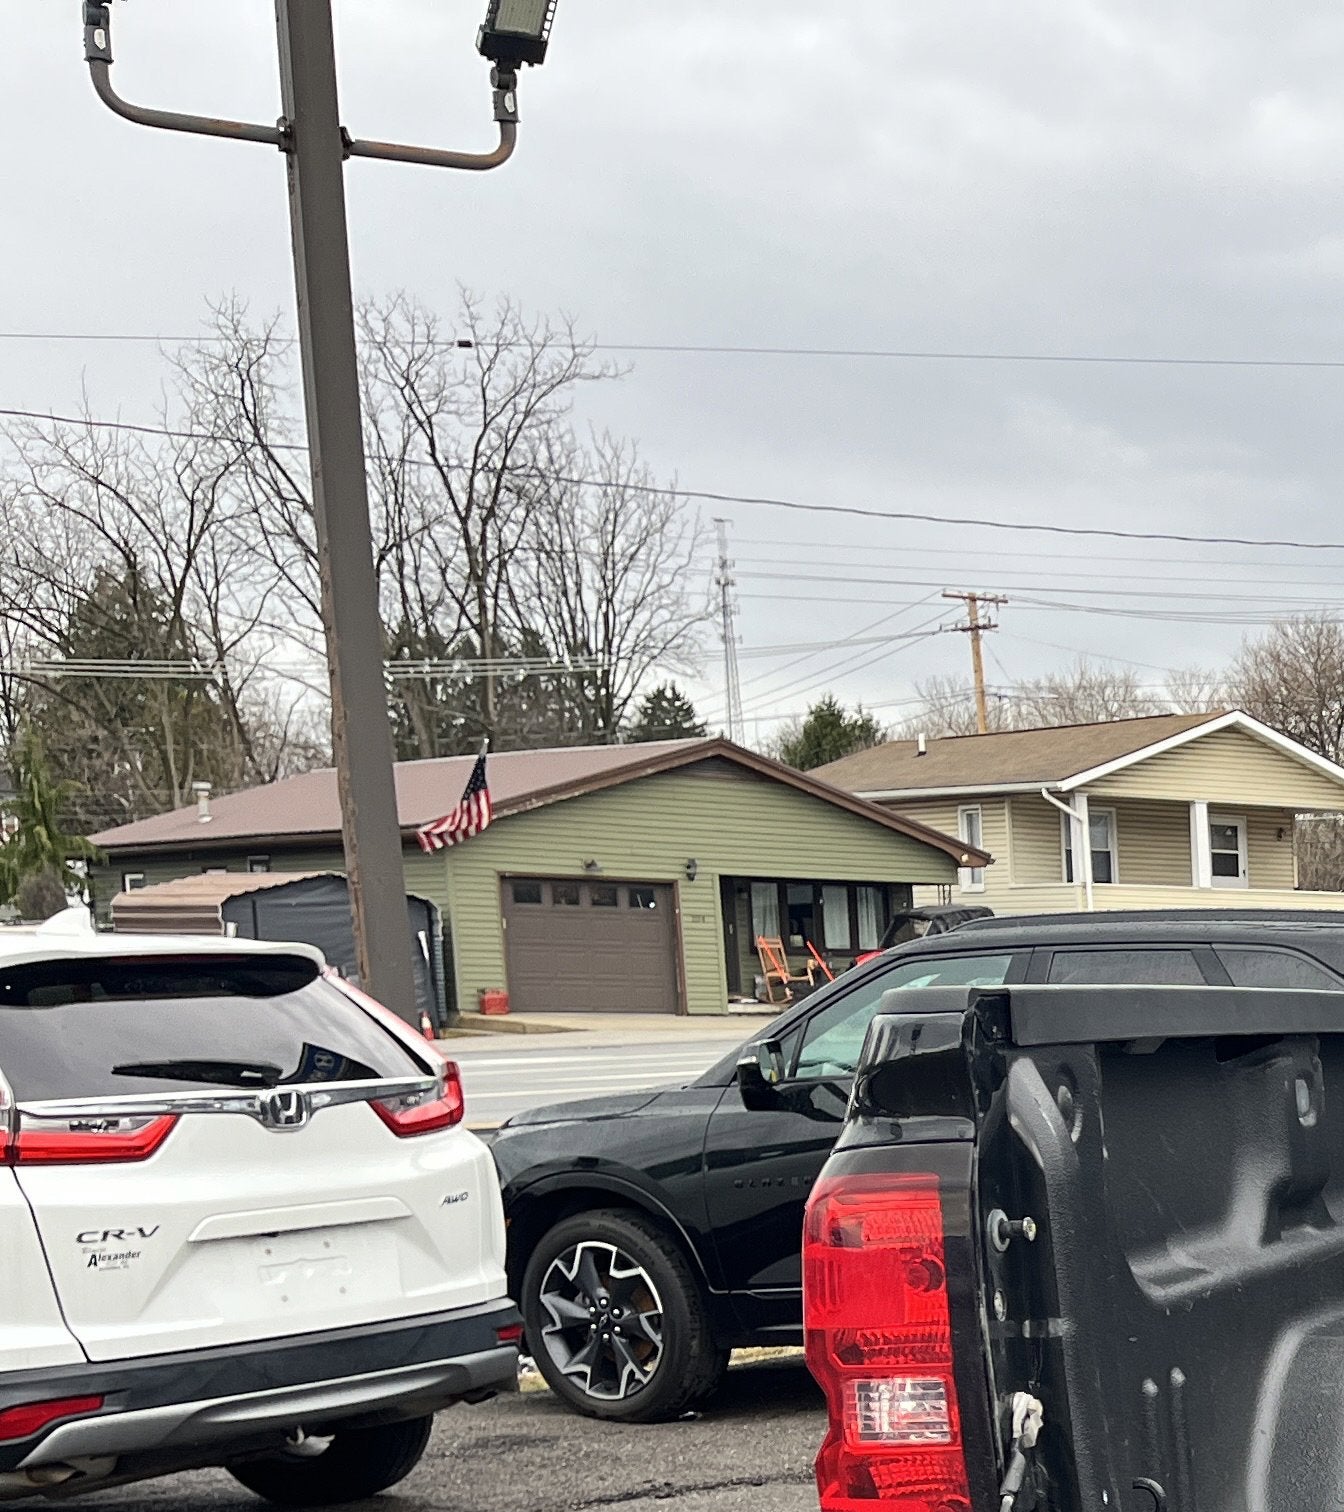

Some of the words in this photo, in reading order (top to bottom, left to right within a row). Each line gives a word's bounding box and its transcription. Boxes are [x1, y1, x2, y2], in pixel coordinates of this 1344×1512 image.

[439, 1191, 469, 1207] AWD
[76, 1223, 160, 1244] CR-V
[86, 1250, 142, 1268] Alexander
